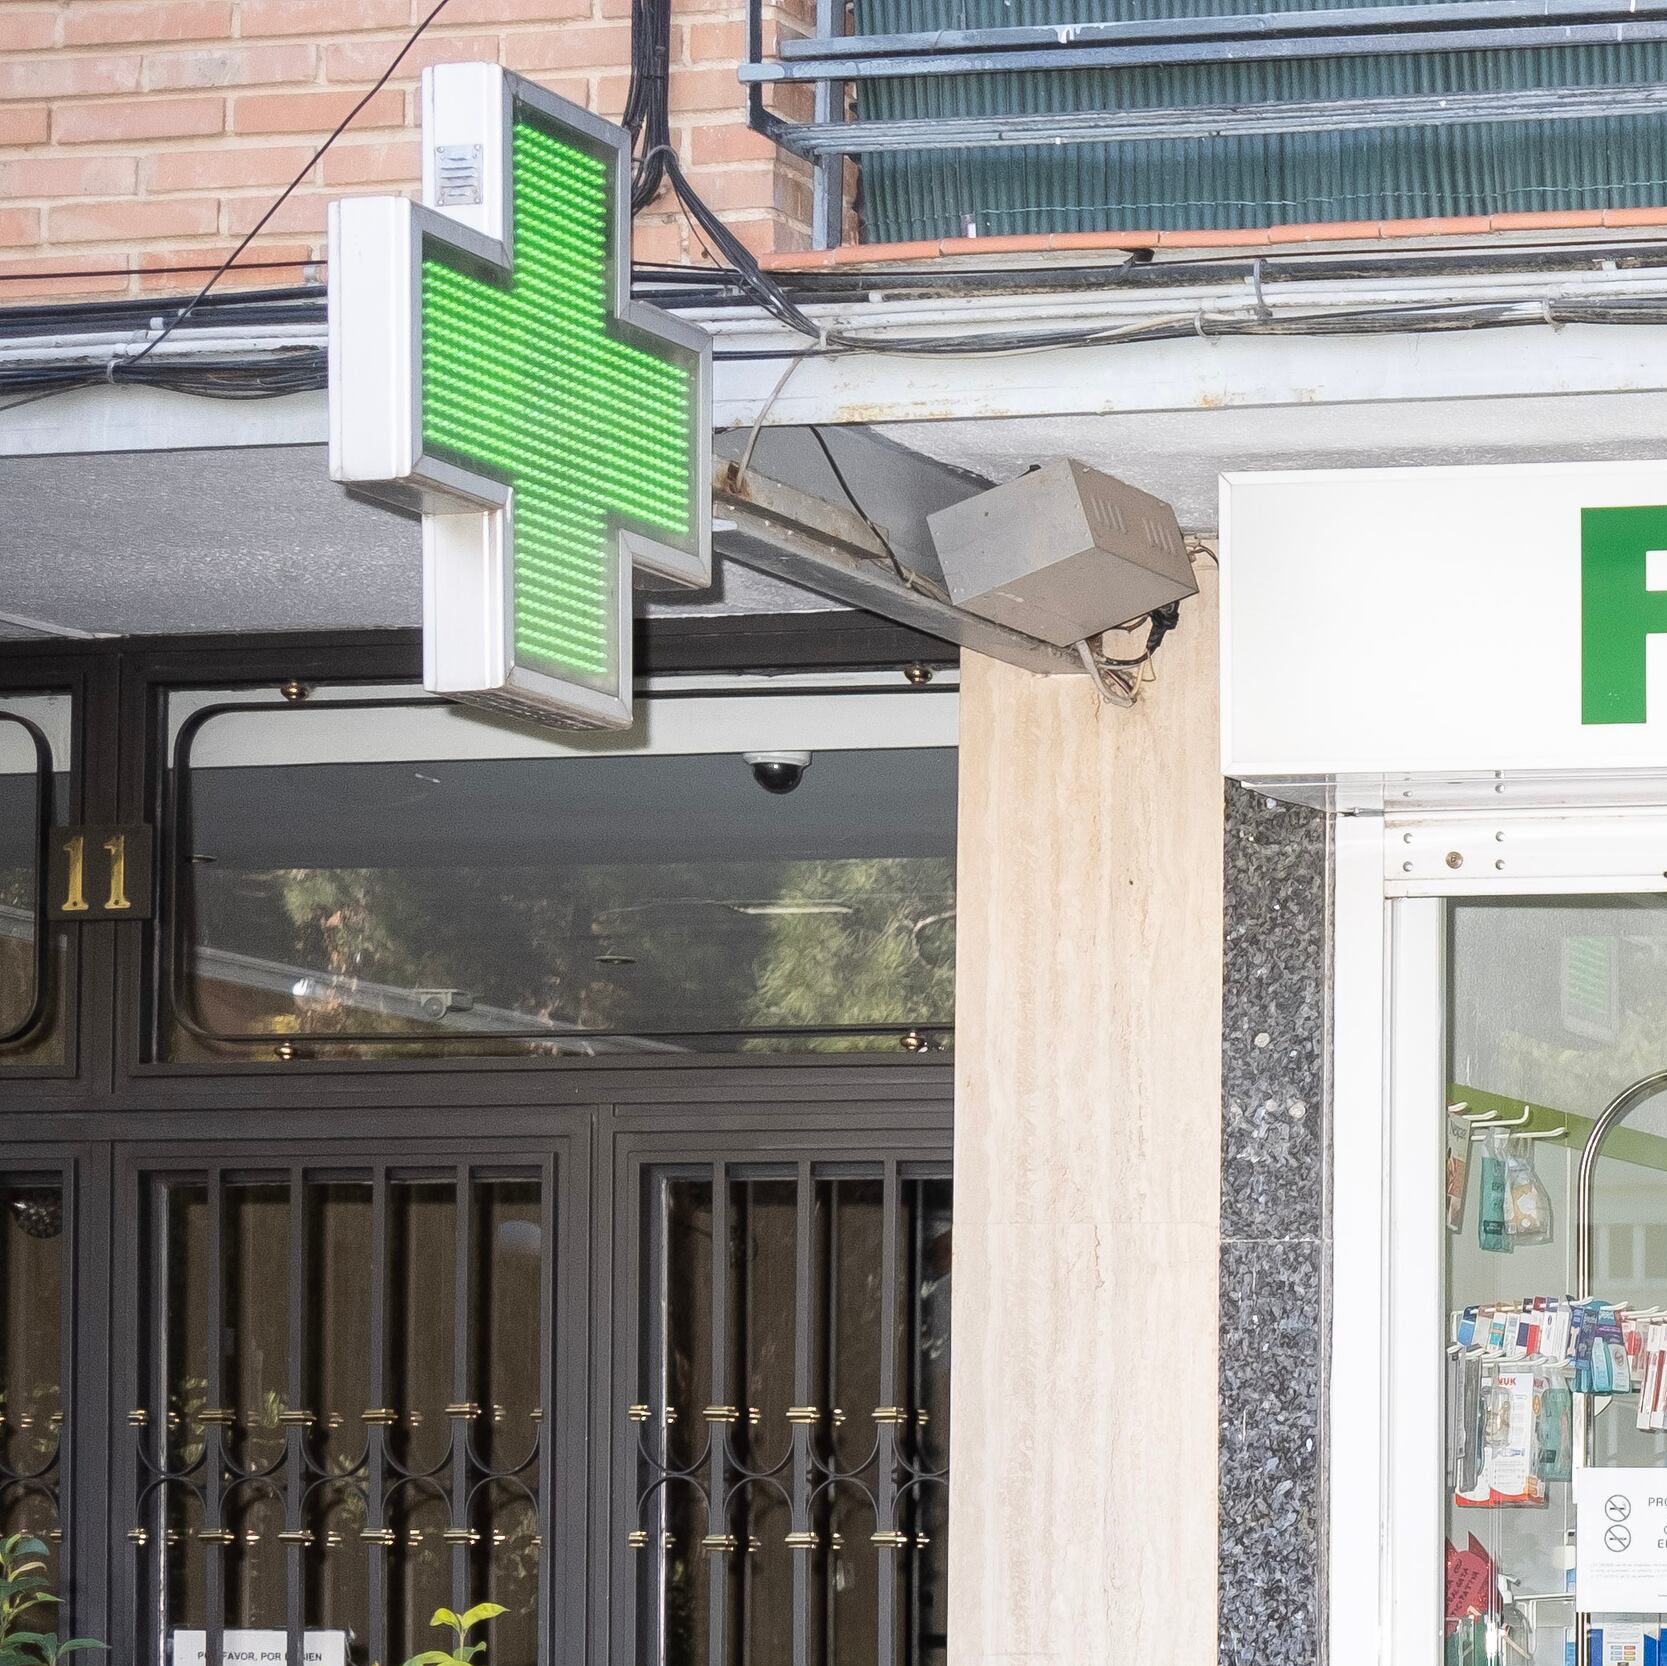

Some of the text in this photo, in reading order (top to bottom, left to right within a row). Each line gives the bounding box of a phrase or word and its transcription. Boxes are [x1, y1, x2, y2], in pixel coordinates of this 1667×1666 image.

[62, 834, 130, 912] 11
[223, 1651, 258, 1662] FAVOR,
[260, 1652, 281, 1661] POR
